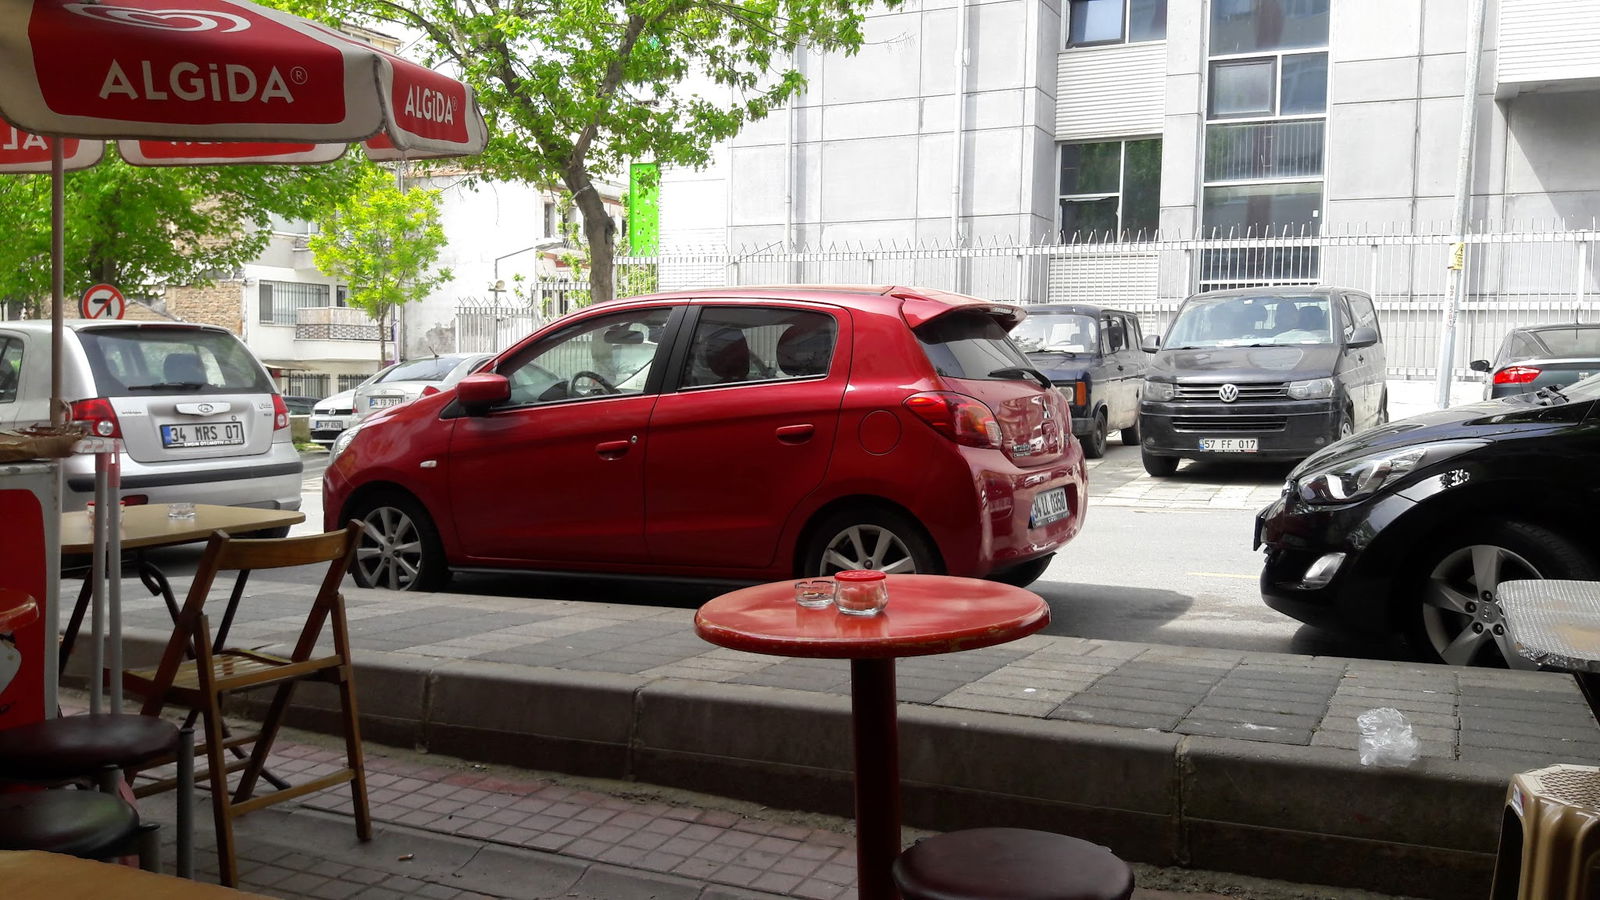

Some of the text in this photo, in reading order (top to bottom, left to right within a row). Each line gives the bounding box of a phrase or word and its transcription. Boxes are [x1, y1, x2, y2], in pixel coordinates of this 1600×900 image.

[171, 425, 239, 442] 34 MRS 07
[1204, 440, 1256, 448] 57 FF 017
